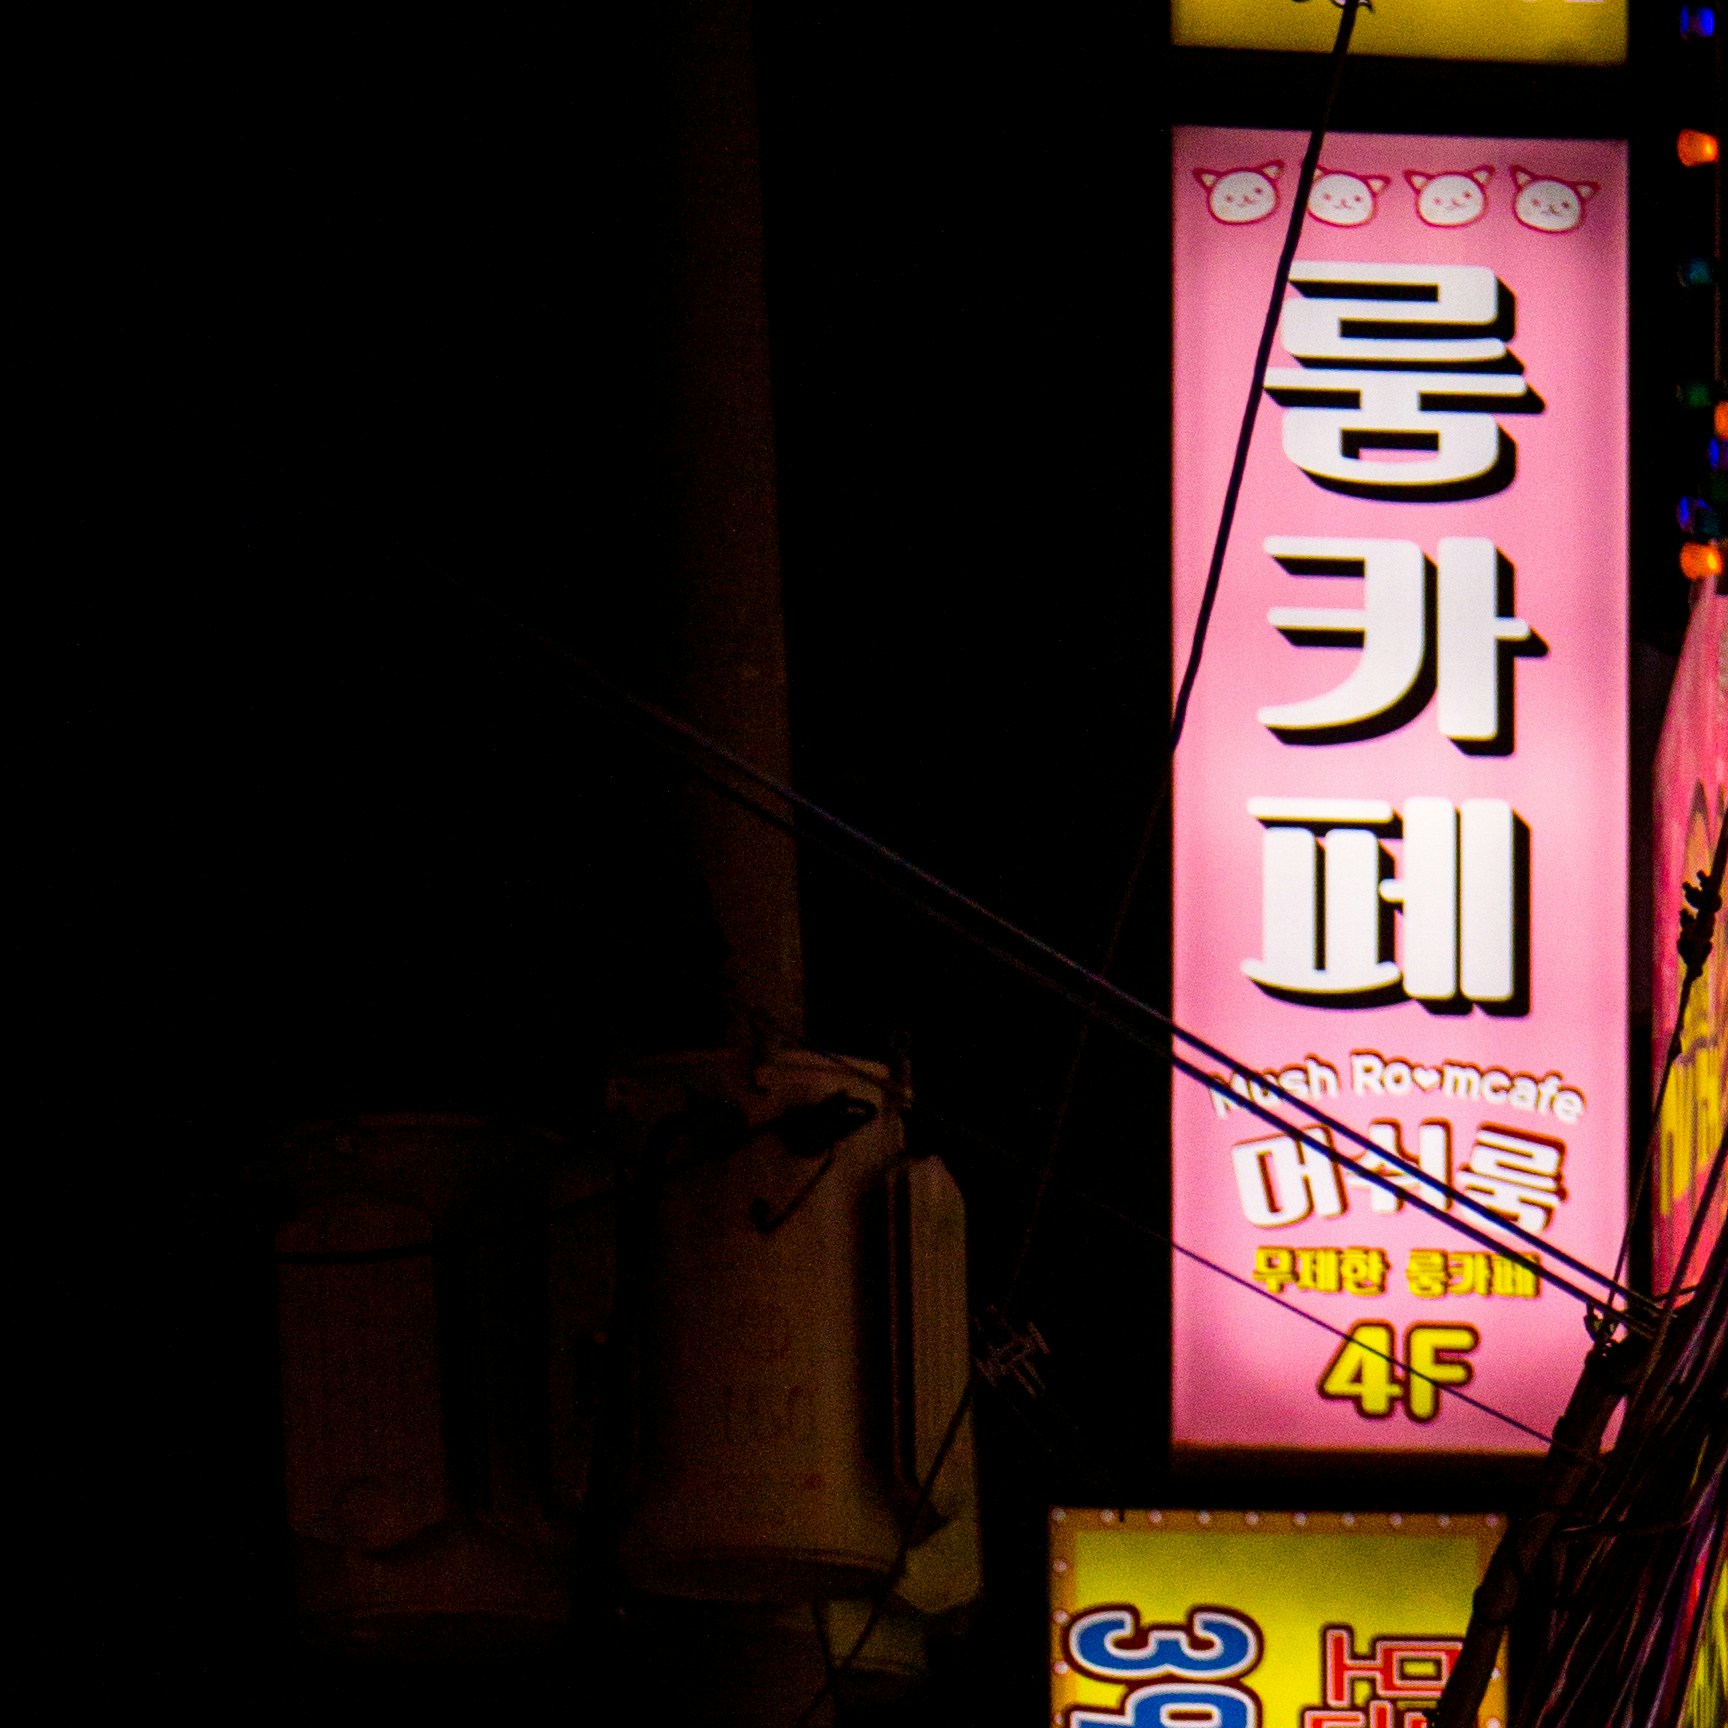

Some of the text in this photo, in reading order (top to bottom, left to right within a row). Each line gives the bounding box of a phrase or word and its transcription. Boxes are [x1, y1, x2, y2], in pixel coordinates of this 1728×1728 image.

[1230, 1118, 1568, 1233] 머쉬룸
[1252, 1246, 1390, 1297] 무제한
[1317, 1319, 1480, 1424] 4F
